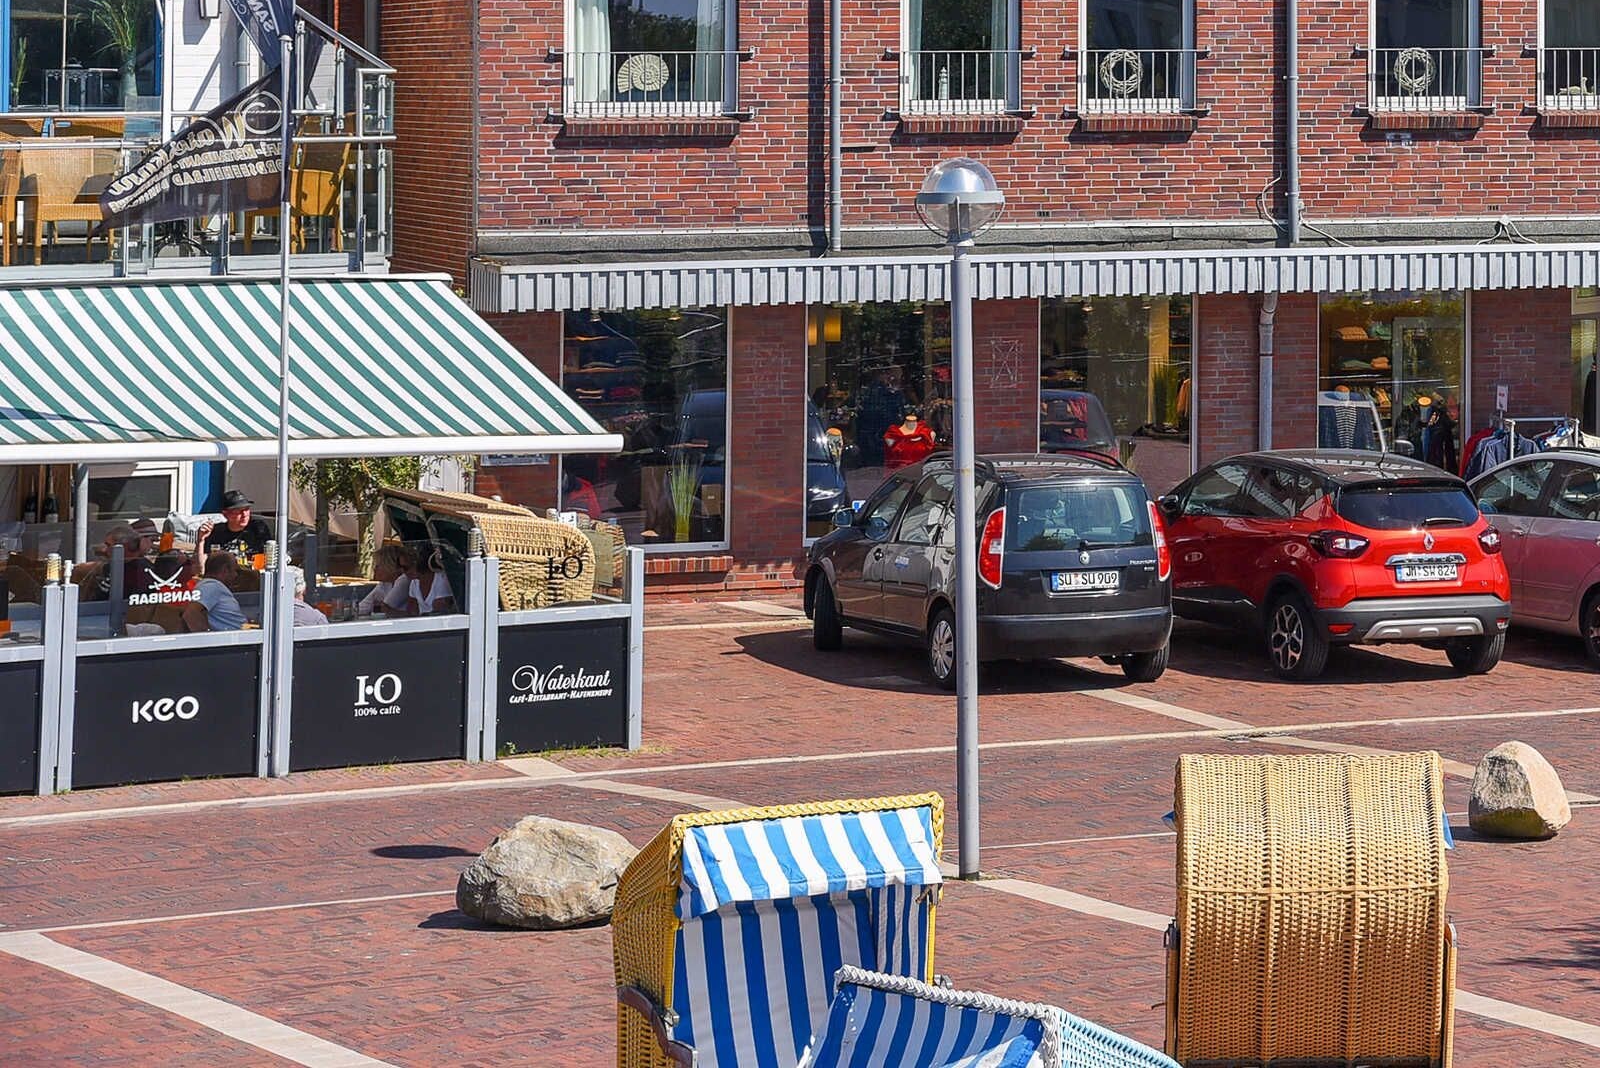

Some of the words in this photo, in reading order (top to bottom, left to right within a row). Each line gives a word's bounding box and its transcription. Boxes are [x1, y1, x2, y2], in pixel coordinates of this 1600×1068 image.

[1058, 572, 1072, 586] SU
[1081, 572, 1096, 585] SU
[1098, 572, 1117, 585] 909
[512, 665, 611, 694] Waterkant
[354, 707, 378, 717] 100%
